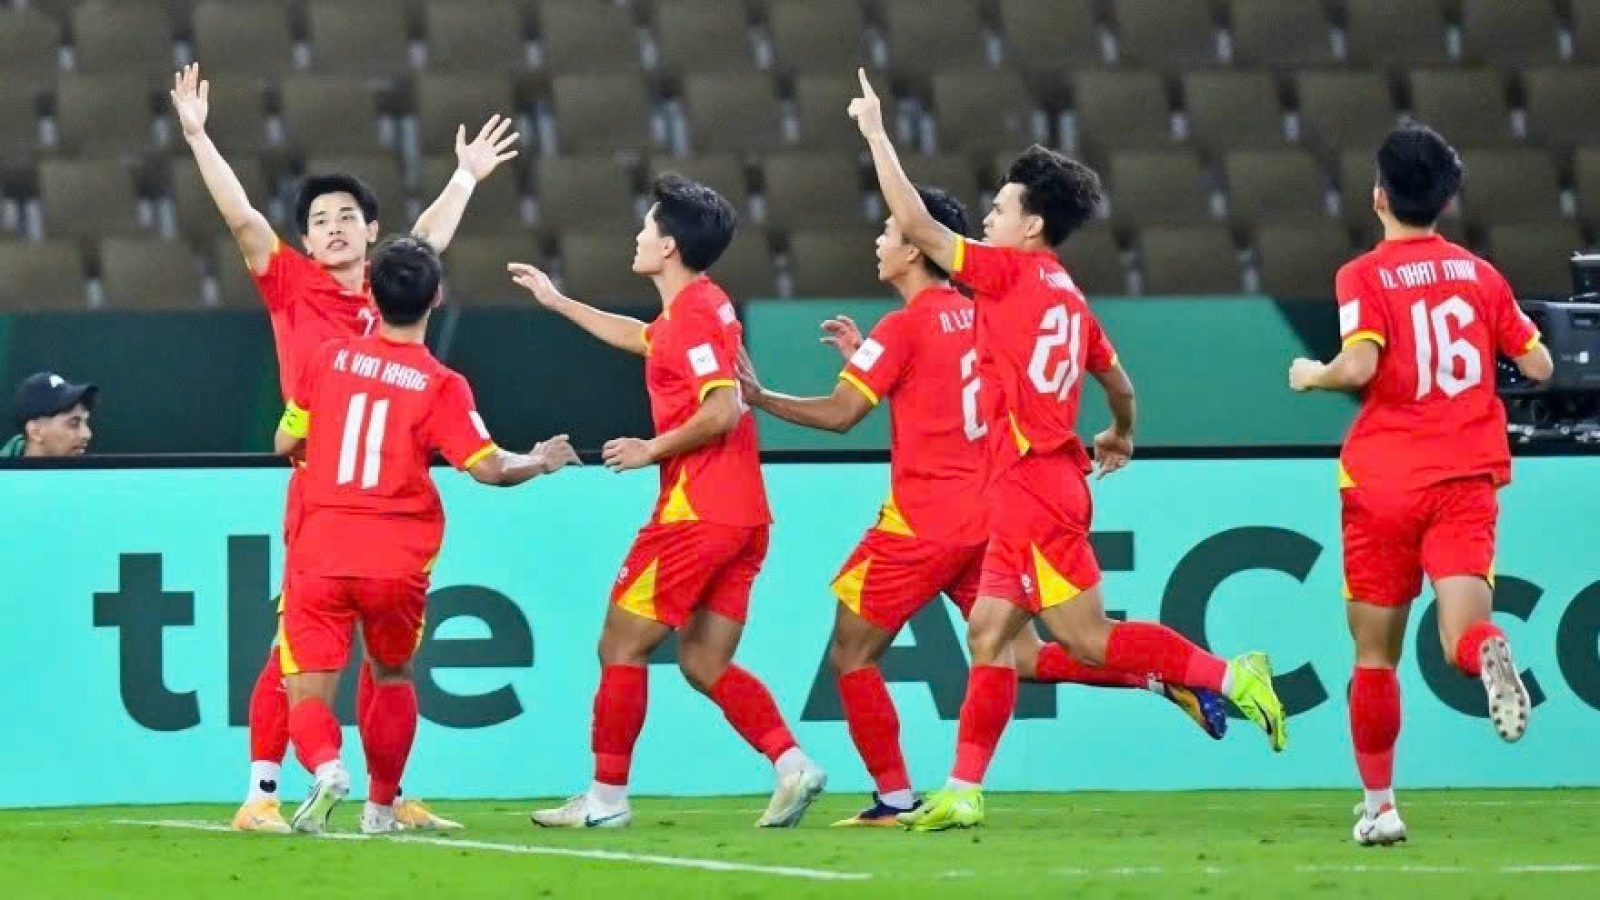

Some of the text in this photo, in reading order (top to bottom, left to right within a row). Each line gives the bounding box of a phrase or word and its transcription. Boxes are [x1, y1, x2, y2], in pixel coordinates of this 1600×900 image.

[1028, 304, 1080, 402] 21
[1411, 295, 1481, 400] 16
[337, 393, 389, 489] 11
[800, 526, 1329, 720] AC
